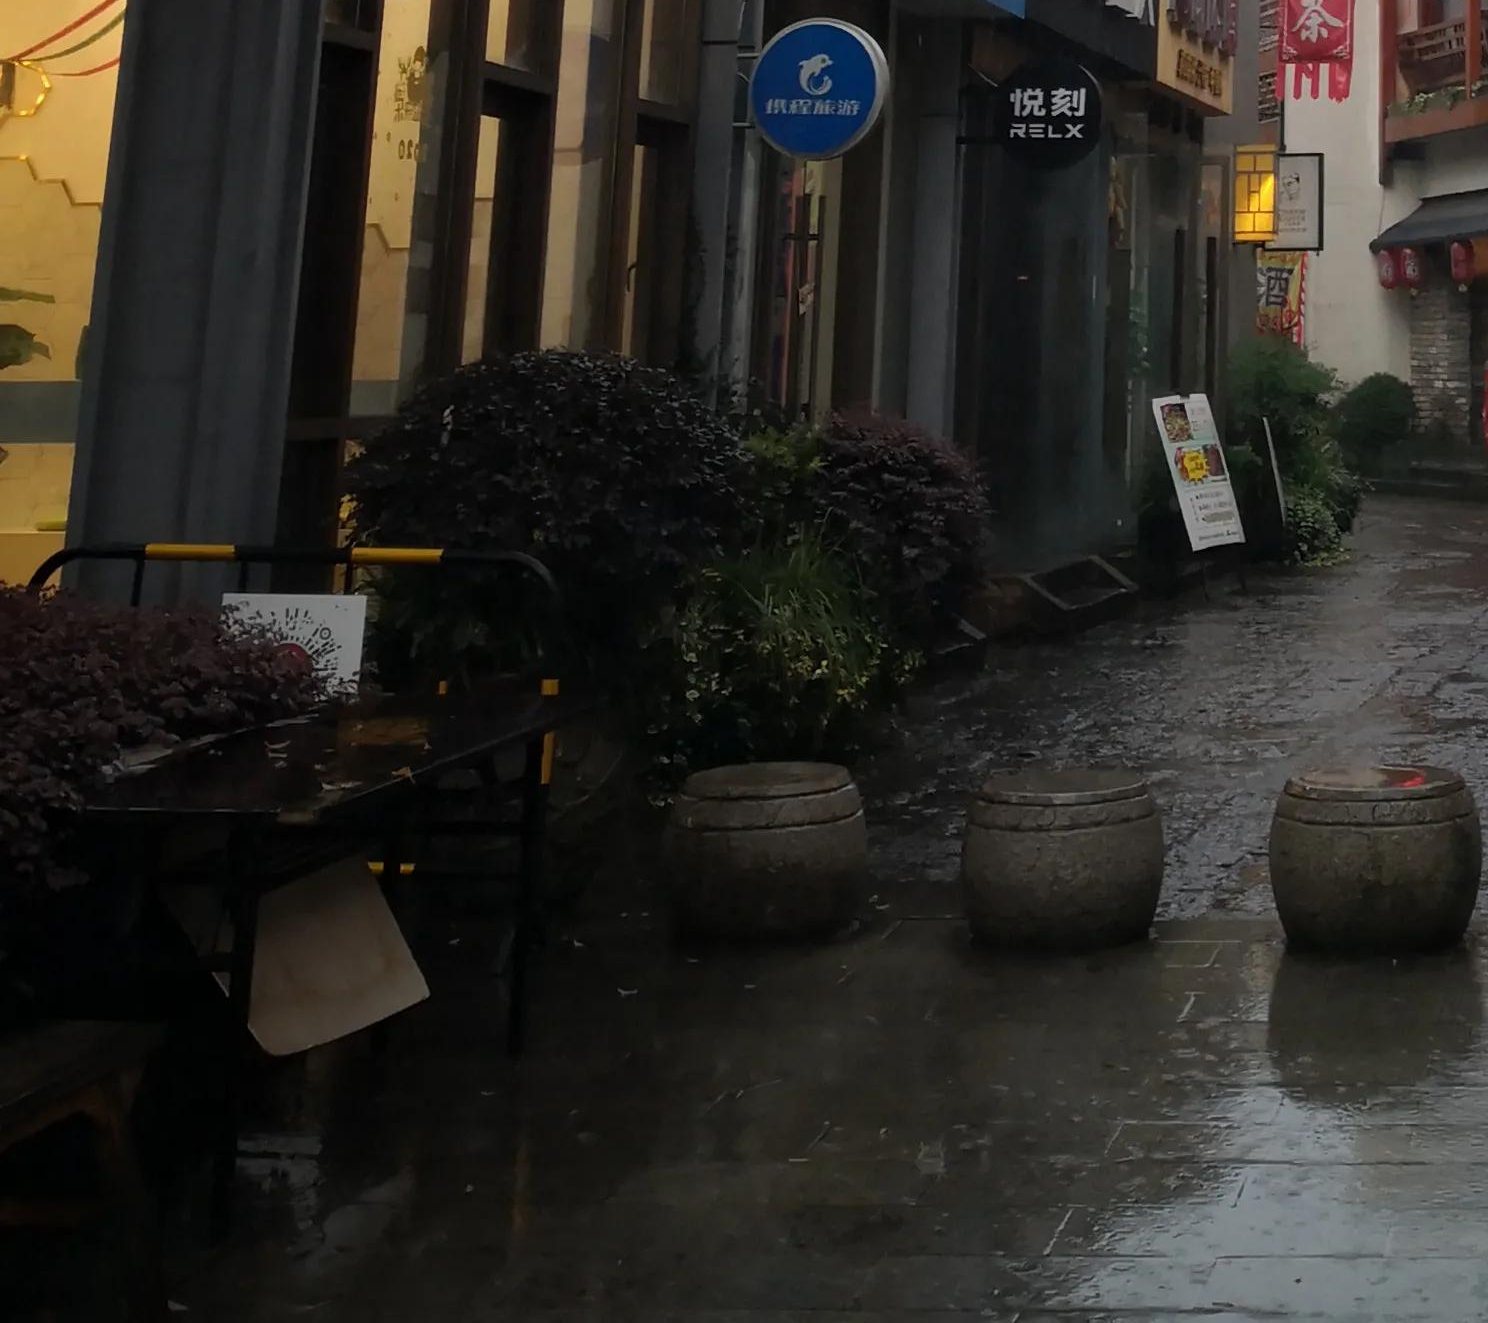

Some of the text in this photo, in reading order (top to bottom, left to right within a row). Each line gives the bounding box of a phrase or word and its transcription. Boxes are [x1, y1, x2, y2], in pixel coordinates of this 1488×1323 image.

[765, 98, 861, 117] 携程旅游
[1008, 87, 1087, 118] 悦刻
[1008, 123, 1085, 140] RELX
